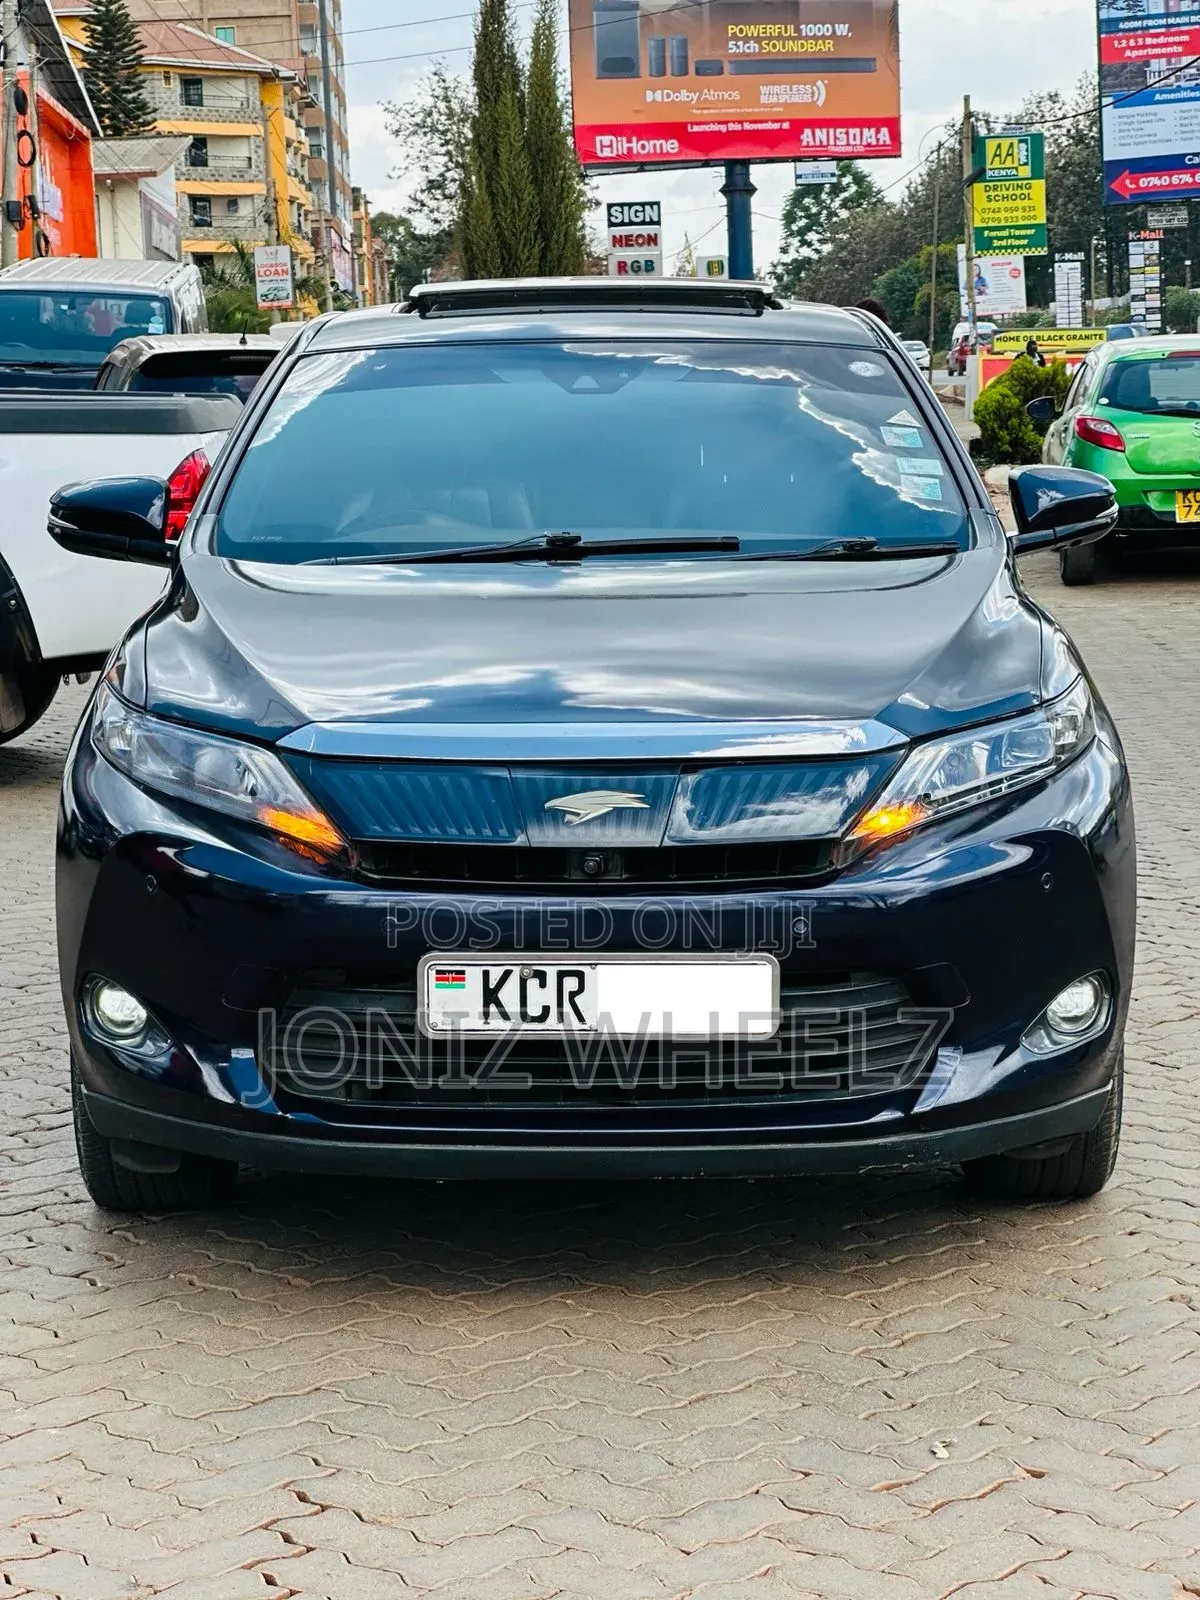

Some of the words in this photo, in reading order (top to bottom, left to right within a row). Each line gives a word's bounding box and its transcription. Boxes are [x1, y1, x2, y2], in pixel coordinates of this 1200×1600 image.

[1143, 18, 1166, 26] FROM
[1168, 16, 1190, 24] MAIN
[728, 24, 798, 36] POWERFUL
[800, 24, 832, 36] 1000
[762, 40, 834, 52] SOUNDBAR
[1128, 38, 1136, 46] &
[1145, 35, 1190, 44] Bedroom
[1124, 46, 1183, 58] Apartments
[760, 84, 812, 96] WIRELESS
[1154, 90, 1200, 101] Amenities
[664, 90, 700, 104] Dolby
[700, 88, 740, 101] Atmos
[688, 124, 727, 133] Launching
[728, 122, 742, 131] this
[743, 122, 780, 130] November
[989, 142, 1016, 166] AA
[988, 168, 1018, 177] KENYA
[984, 182, 1032, 192] DRIVING
[1139, 176, 1170, 187] 0740
[986, 192, 1033, 202] SCHOOL
[610, 204, 658, 223] SIGN
[612, 233, 658, 248] NEON
[1128, 230, 1164, 240] K-Mall
[257, 268, 289, 278] LOAN
[616, 260, 655, 275] RGB
[1066, 333, 1104, 341] GRANITE
[482, 969, 587, 1025] KCR
